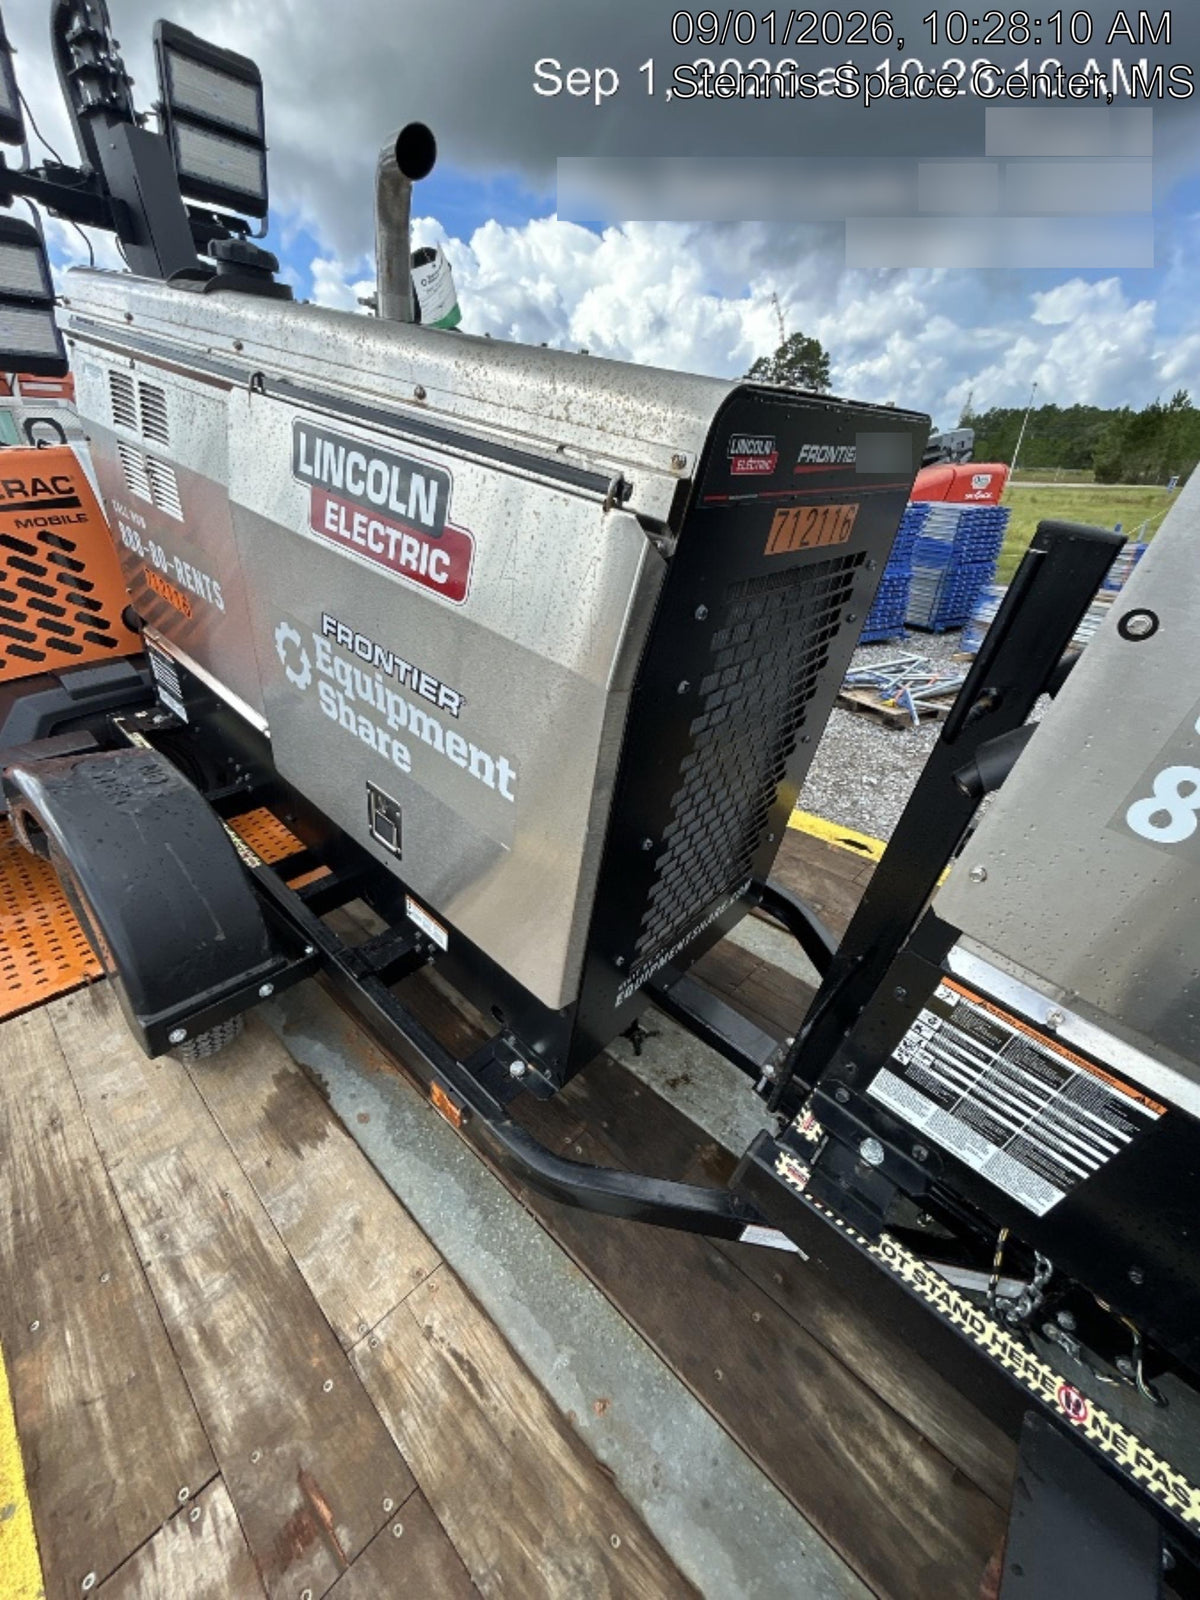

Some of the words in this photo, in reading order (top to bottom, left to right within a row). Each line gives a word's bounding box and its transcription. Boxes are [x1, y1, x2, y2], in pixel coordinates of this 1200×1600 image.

[0, 476, 75, 499] RAC
[299, 431, 439, 527] LINCOLN
[730, 438, 773, 454] LINCOLN
[736, 458, 772, 471] ELECTRIC
[797, 444, 856, 463] FRONTIE
[14, 513, 88, 529] MOBILE
[324, 499, 450, 584] ELECTRIC
[770, 508, 857, 551] 712116
[321, 612, 464, 718] FRONTIER
[312, 632, 517, 802] Equipment
[318, 680, 412, 773] Share
[881, 1242, 911, 1269] OT
[912, 1267, 986, 1334] STAND
[991, 1332, 1057, 1390] HERE
[1091, 1414, 1128, 1457] NE
[1134, 1450, 1192, 1508] PAS
